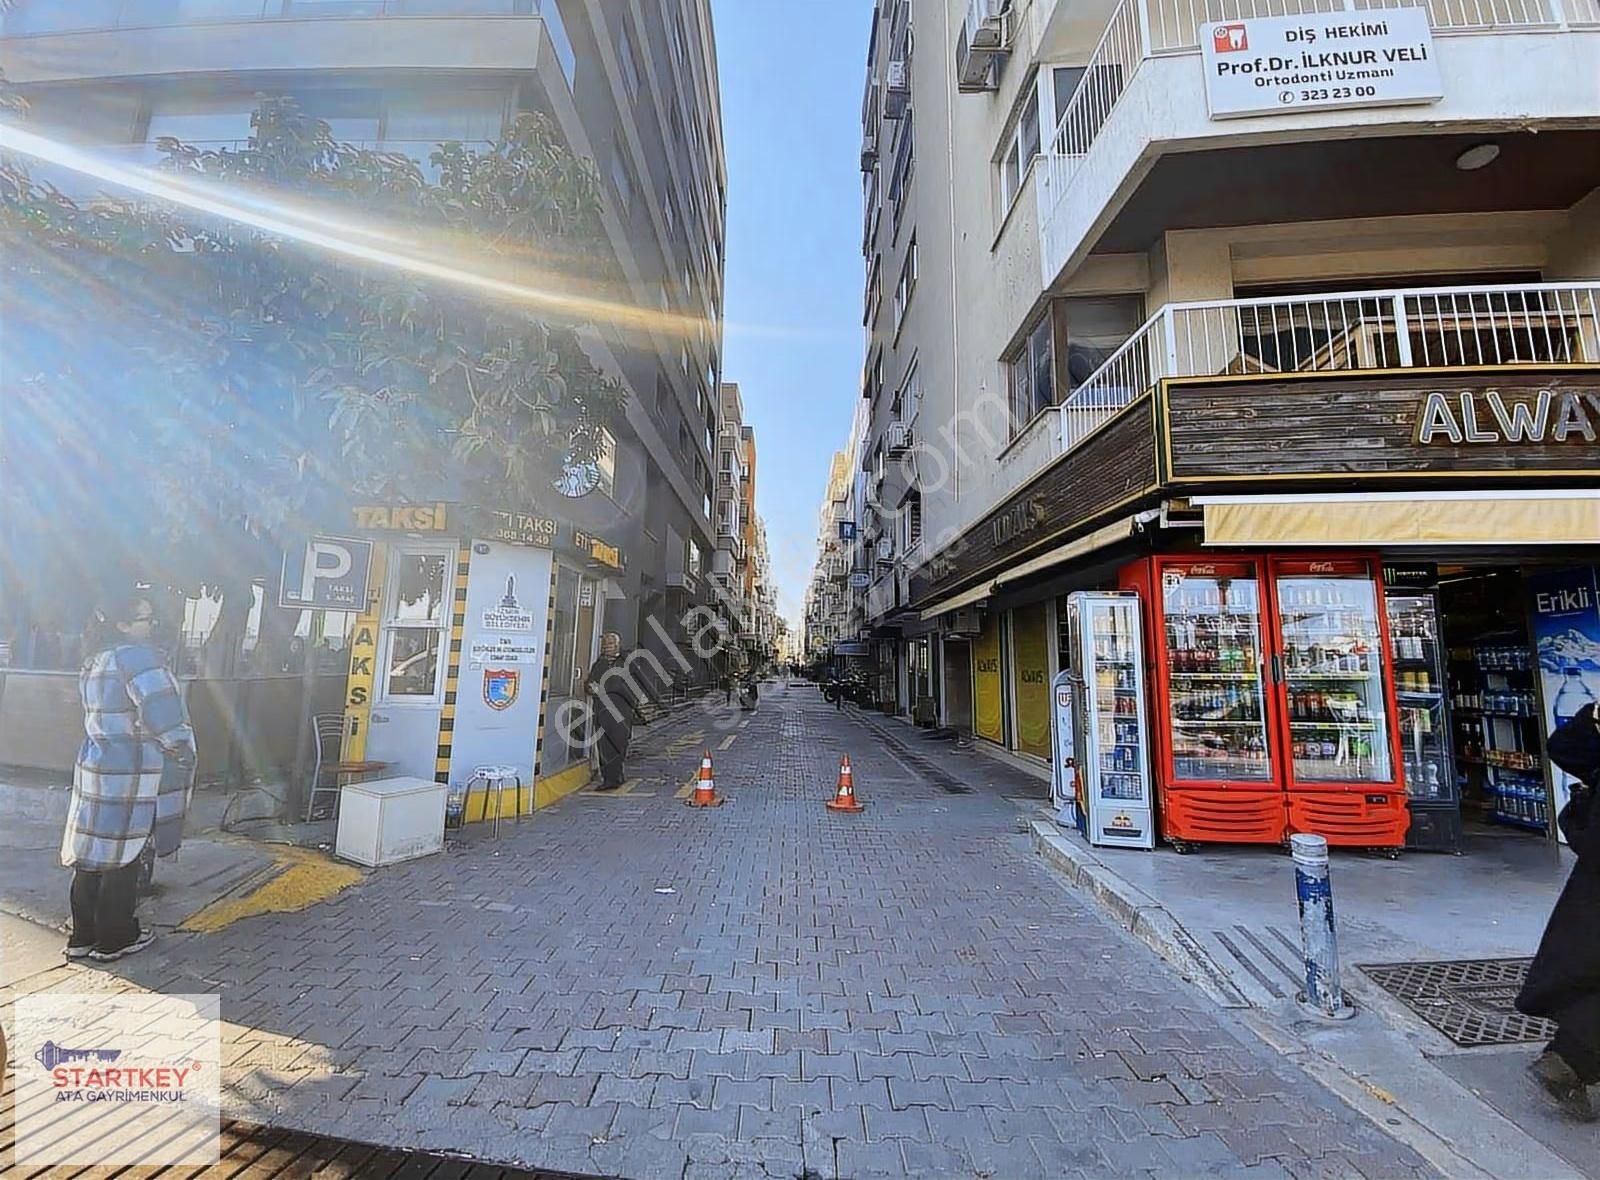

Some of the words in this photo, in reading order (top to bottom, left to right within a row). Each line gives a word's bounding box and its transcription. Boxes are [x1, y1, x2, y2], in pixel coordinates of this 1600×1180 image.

[1286, 26, 1316, 44] DİŞ
[1325, 20, 1388, 40] HEKİMİ
[1302, 48, 1377, 68] İLKNUR
[1383, 43, 1428, 62] VELİ
[1254, 71, 1332, 87] Ortodonti
[1336, 68, 1394, 81] Uzmanı
[1300, 89, 1329, 101] 323
[1333, 87, 1352, 99] 23
[1355, 86, 1376, 97] 00
[301, 541, 352, 602] P
[1536, 587, 1590, 612] Erikli
